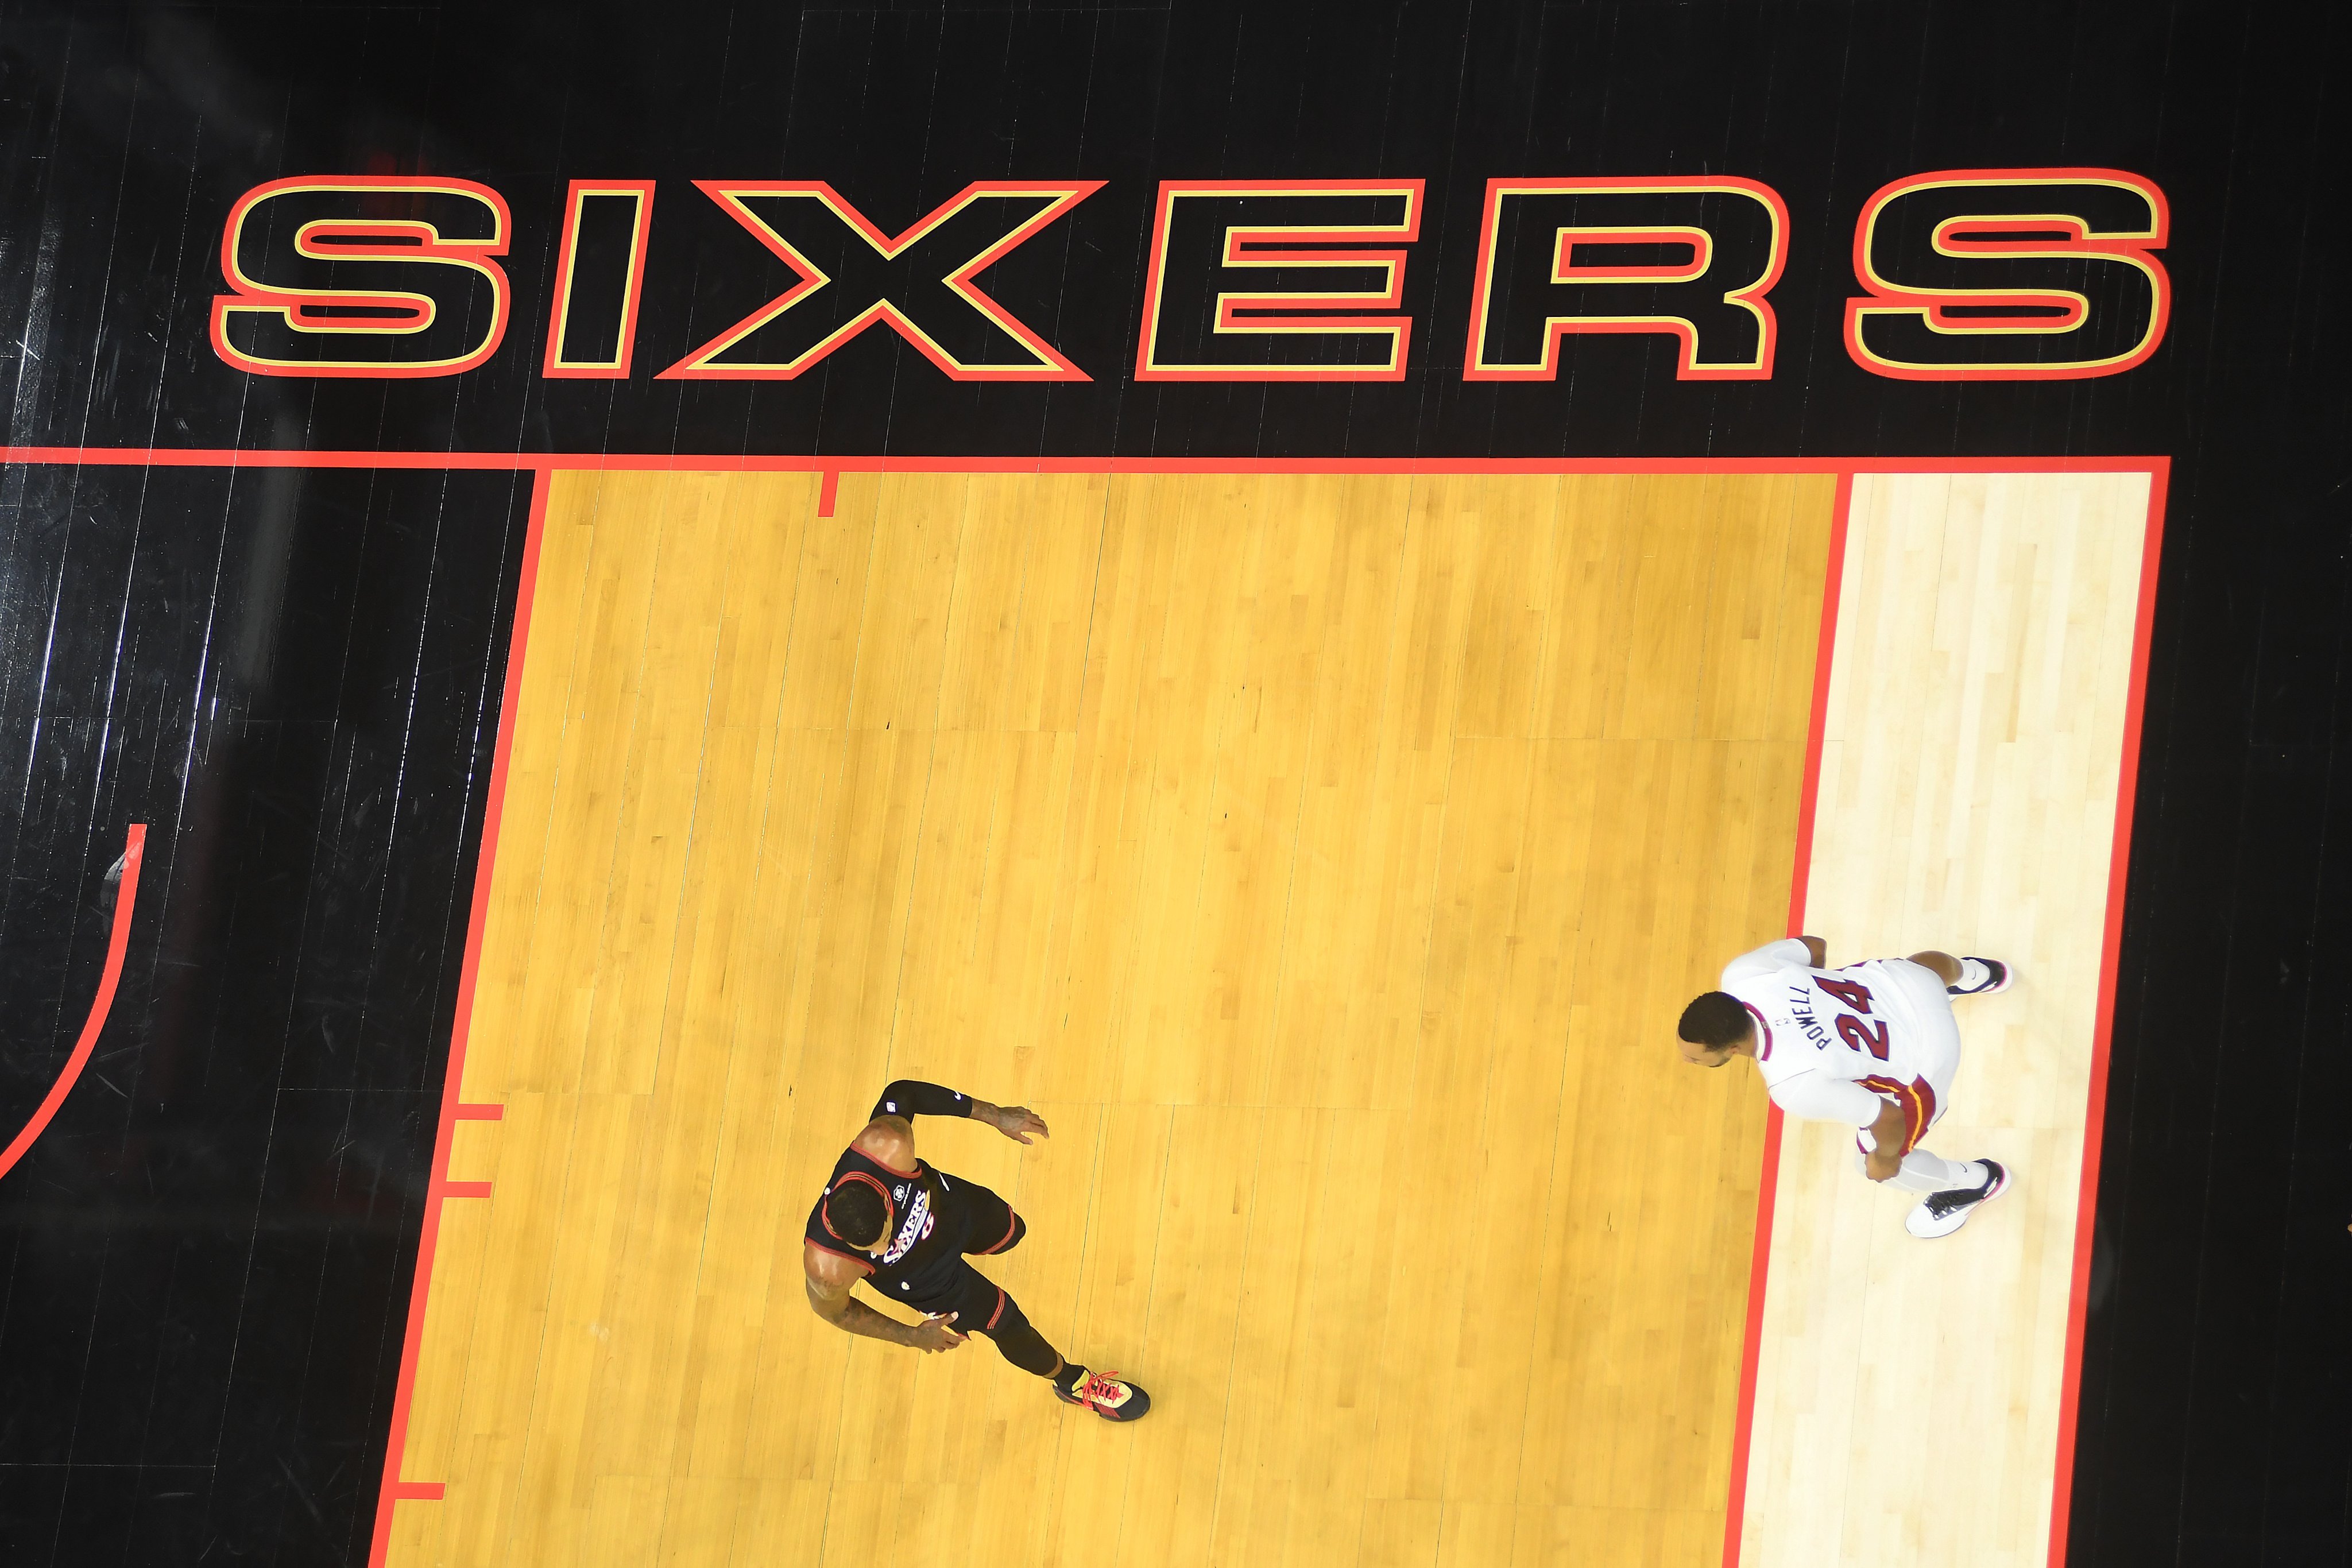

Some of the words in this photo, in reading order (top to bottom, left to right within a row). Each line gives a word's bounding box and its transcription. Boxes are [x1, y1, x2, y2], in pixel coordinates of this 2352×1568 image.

[210, 167, 2171, 381] SIXERS
[1789, 986, 1832, 1051] POWELL
[1812, 975, 1890, 1062] 24
[883, 1189, 927, 1264] SIXERS
